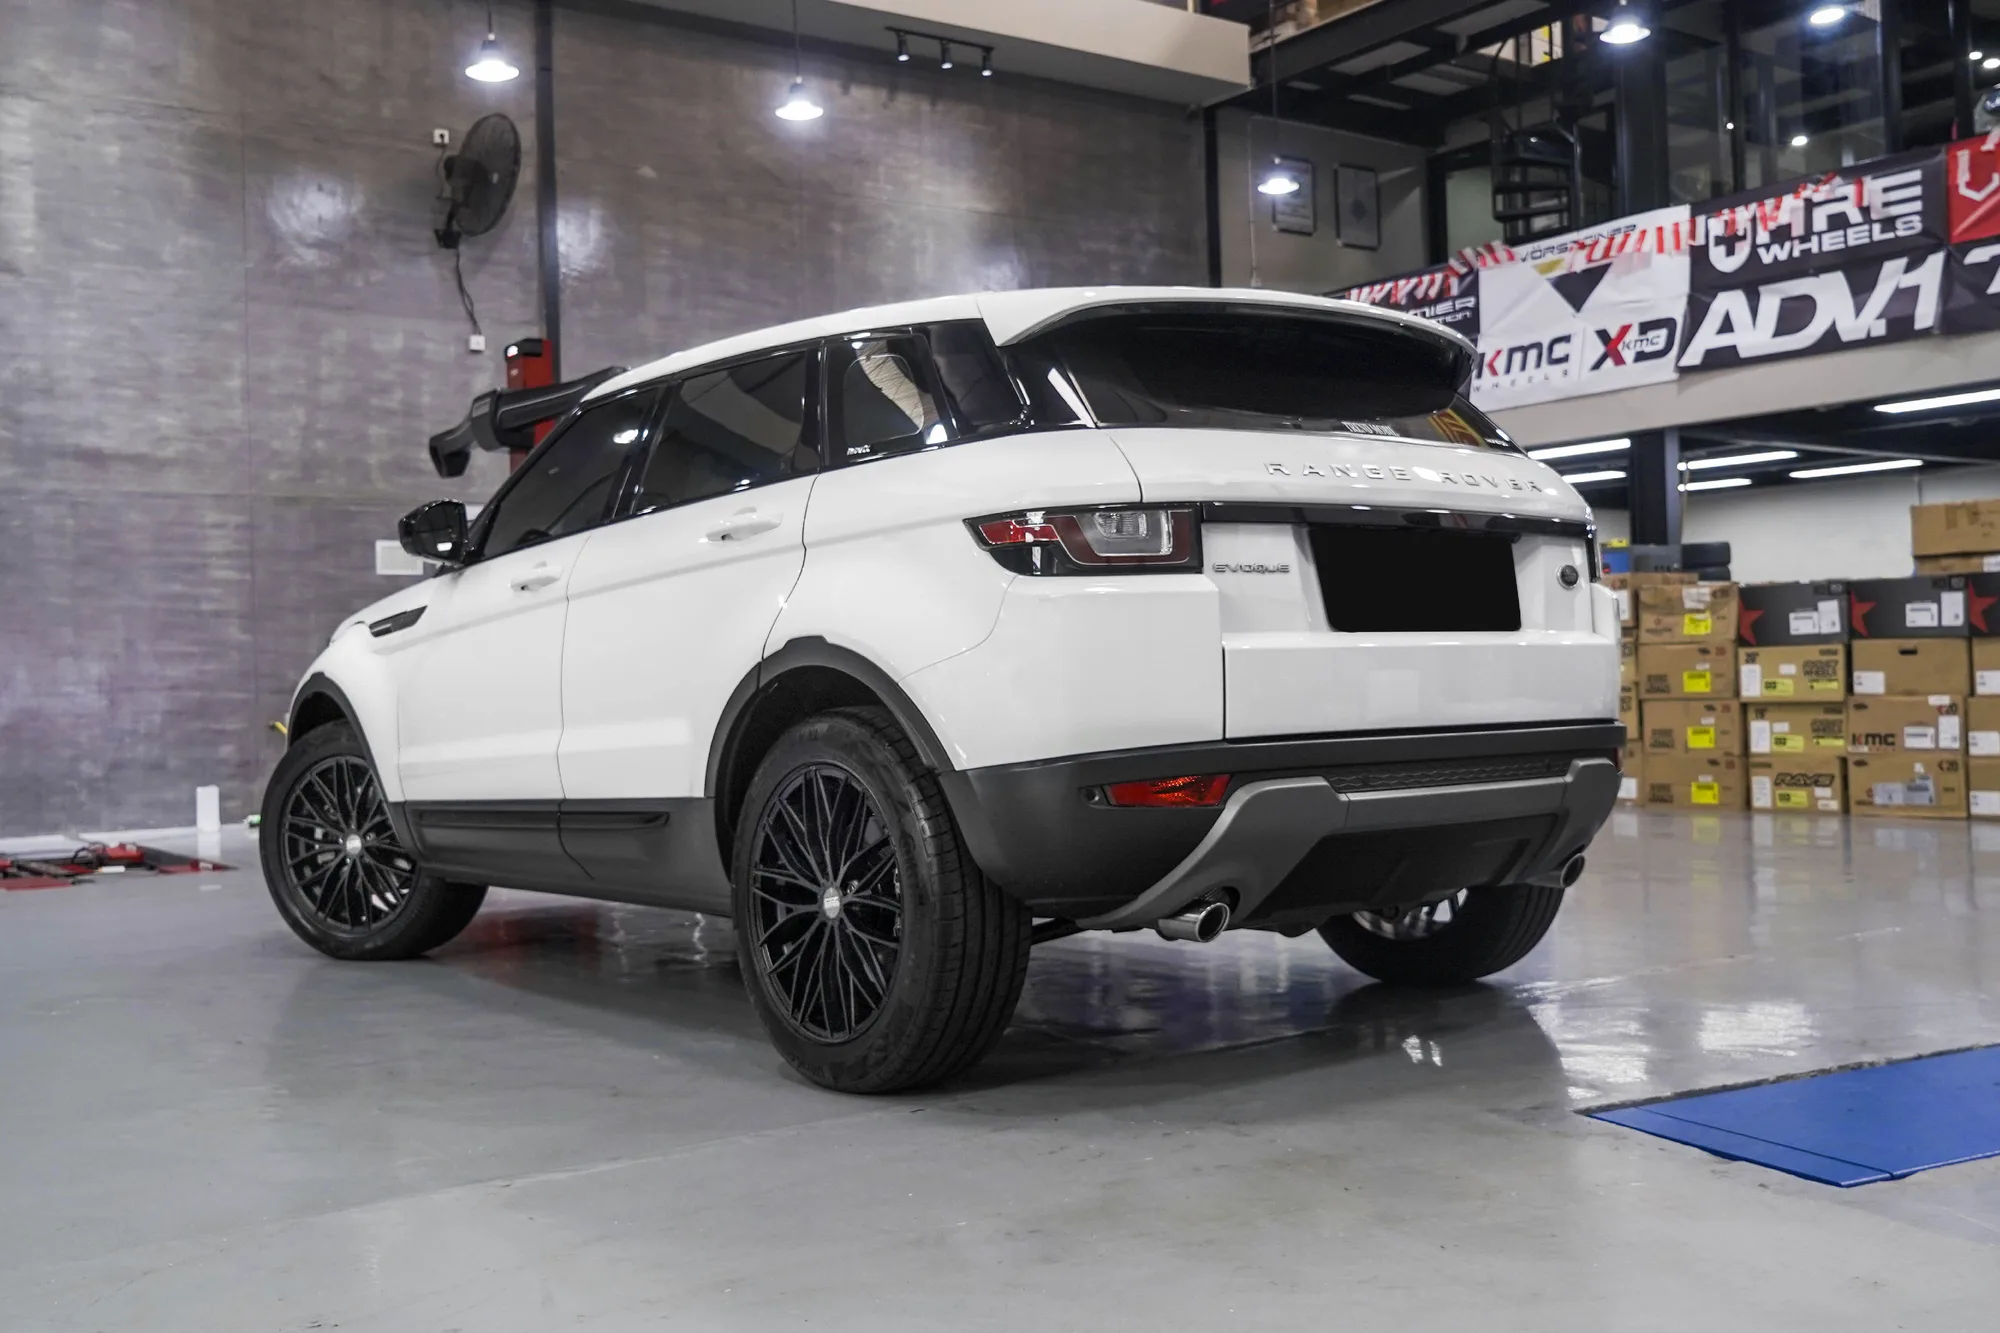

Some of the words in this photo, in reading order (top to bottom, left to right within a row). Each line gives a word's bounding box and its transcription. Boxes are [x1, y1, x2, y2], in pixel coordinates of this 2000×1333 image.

[1757, 215, 1922, 265] WHEELS
[1407, 296, 1477, 318] MIER
[1677, 250, 1947, 368] ADV.1
[1475, 334, 1572, 380] KMC
[1472, 369, 1569, 393] WHEELS
[1263, 463, 1411, 480] RANGE
[1438, 472, 1543, 492] ROVER
[1212, 562, 1291, 574] EVOQUE
[1852, 733, 1896, 746] KMC
[1774, 772, 1836, 788] RAYS
